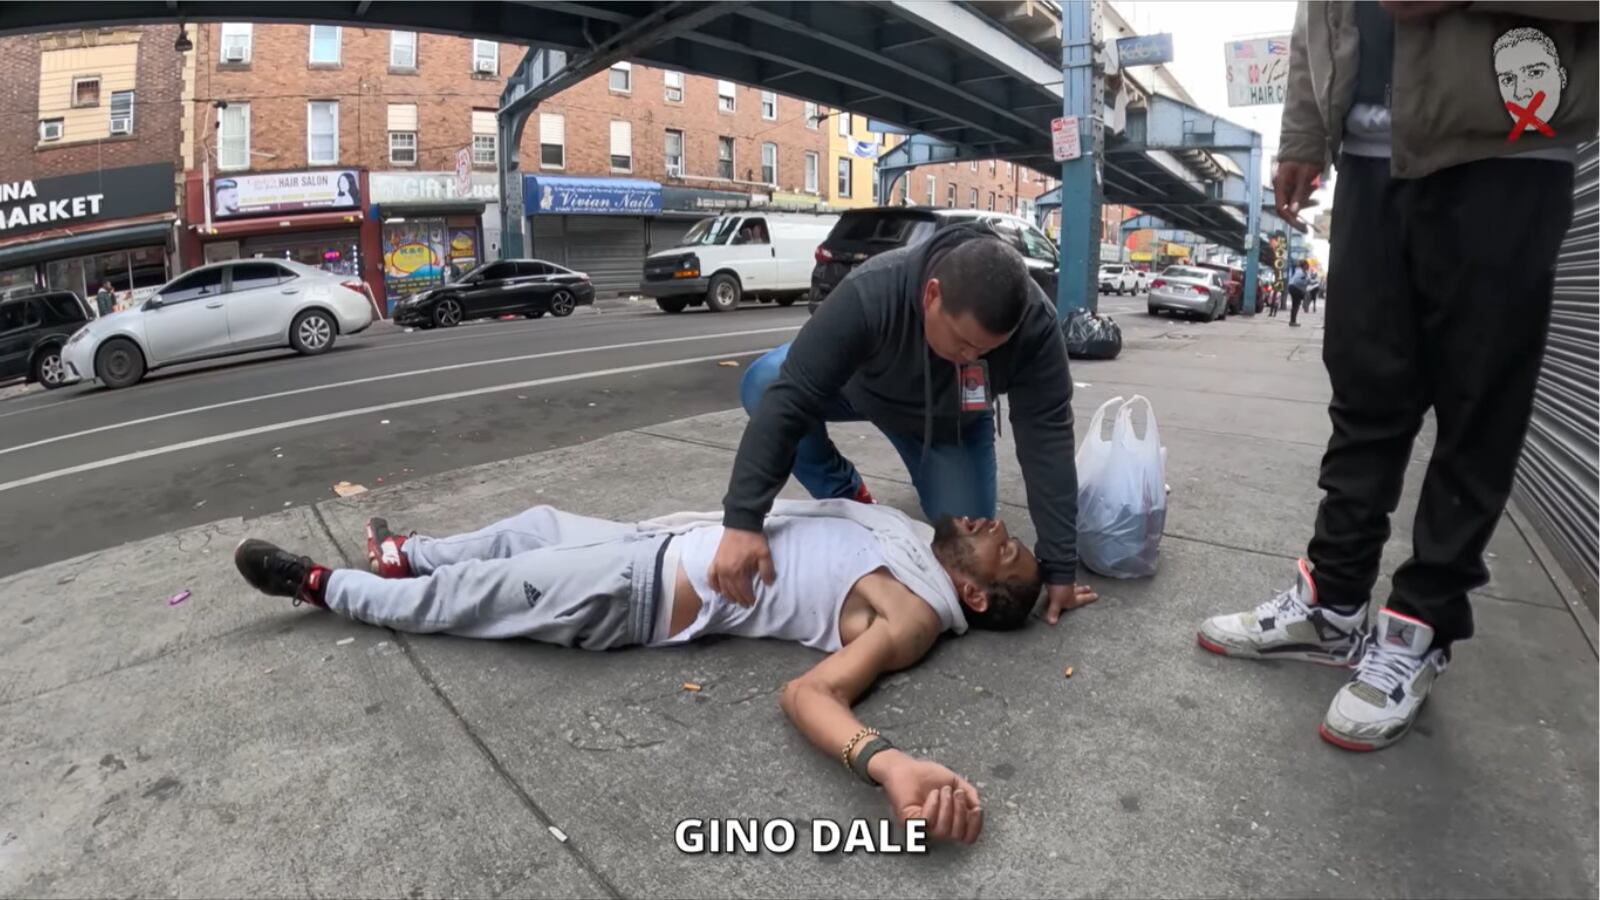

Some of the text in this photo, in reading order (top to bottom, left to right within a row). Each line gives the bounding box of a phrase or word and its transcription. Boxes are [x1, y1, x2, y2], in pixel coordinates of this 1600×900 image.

[1250, 86, 1275, 104] HAIR
[278, 177, 299, 188] HAIR
[301, 175, 329, 187] SALON
[403, 177, 441, 198] Gift
[560, 191, 654, 209] Vivian Nails
